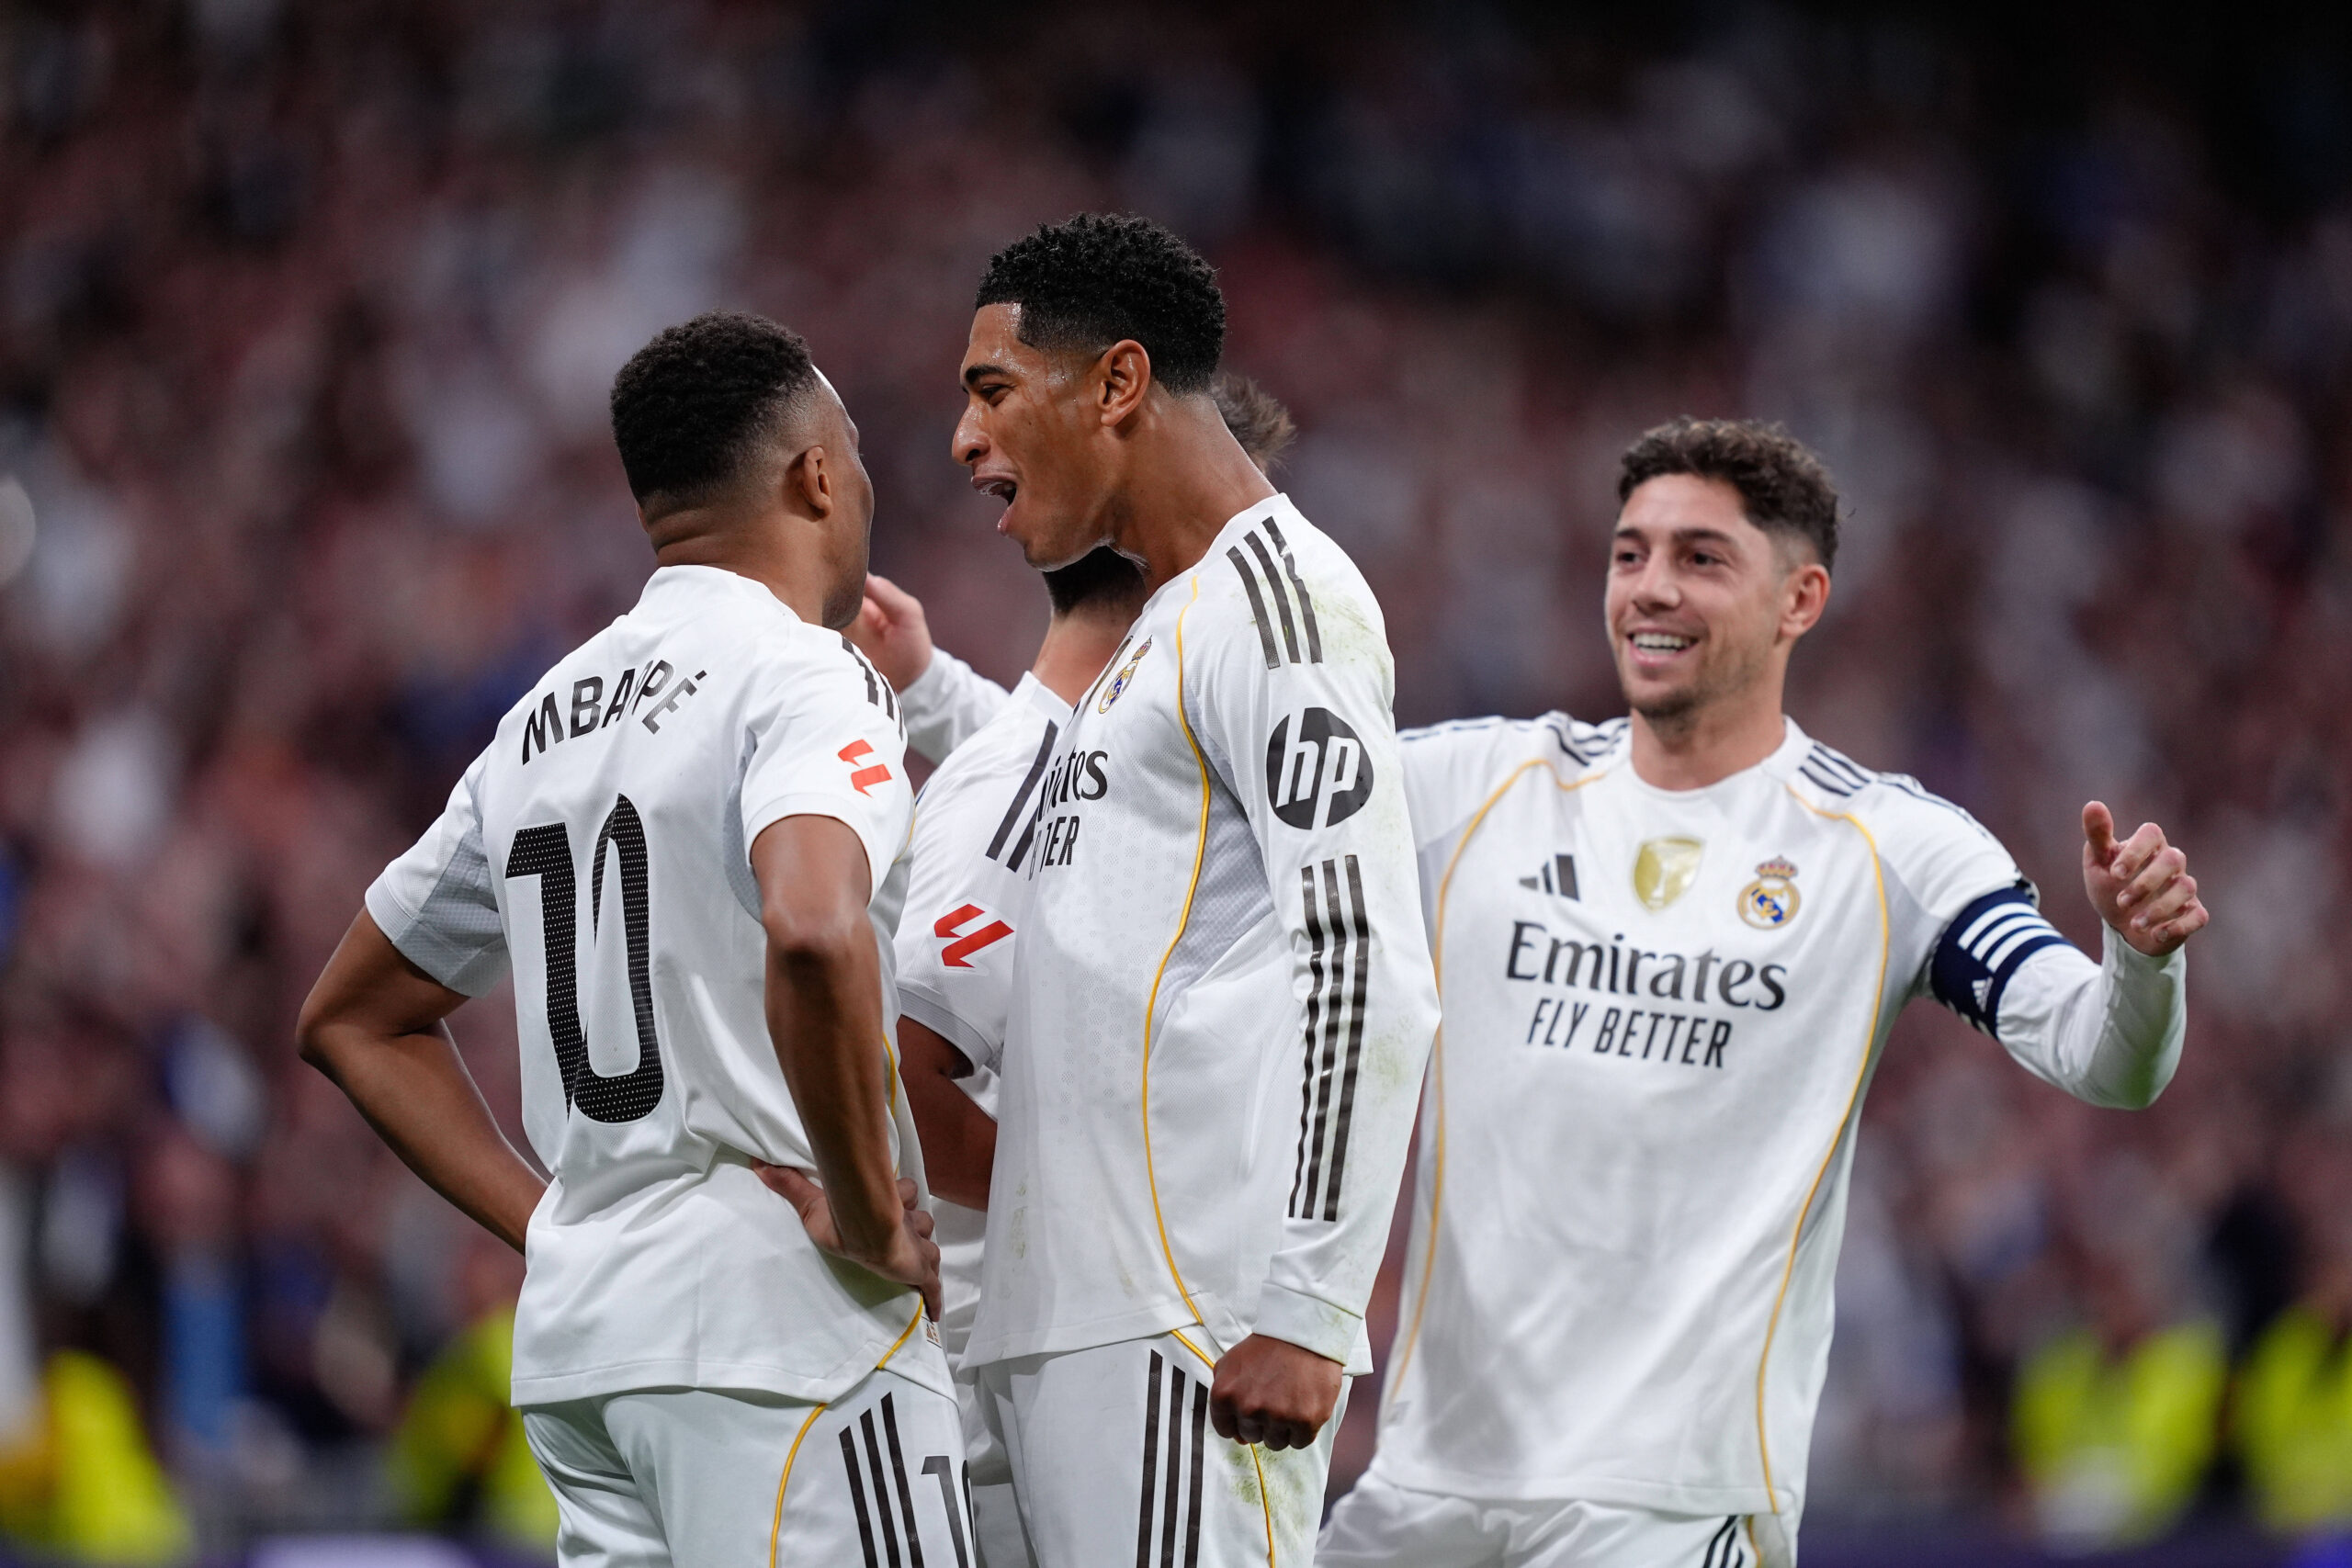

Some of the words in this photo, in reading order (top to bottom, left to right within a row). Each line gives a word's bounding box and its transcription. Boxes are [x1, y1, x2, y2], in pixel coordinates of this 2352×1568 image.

[1272, 706, 1363, 830] hp
[504, 793, 665, 1124] 10
[1505, 919, 1788, 1011] Emirates
[1526, 998, 1589, 1049] FLY
[1593, 1006, 1734, 1069] BETTER
[921, 1455, 976, 1568] 1
